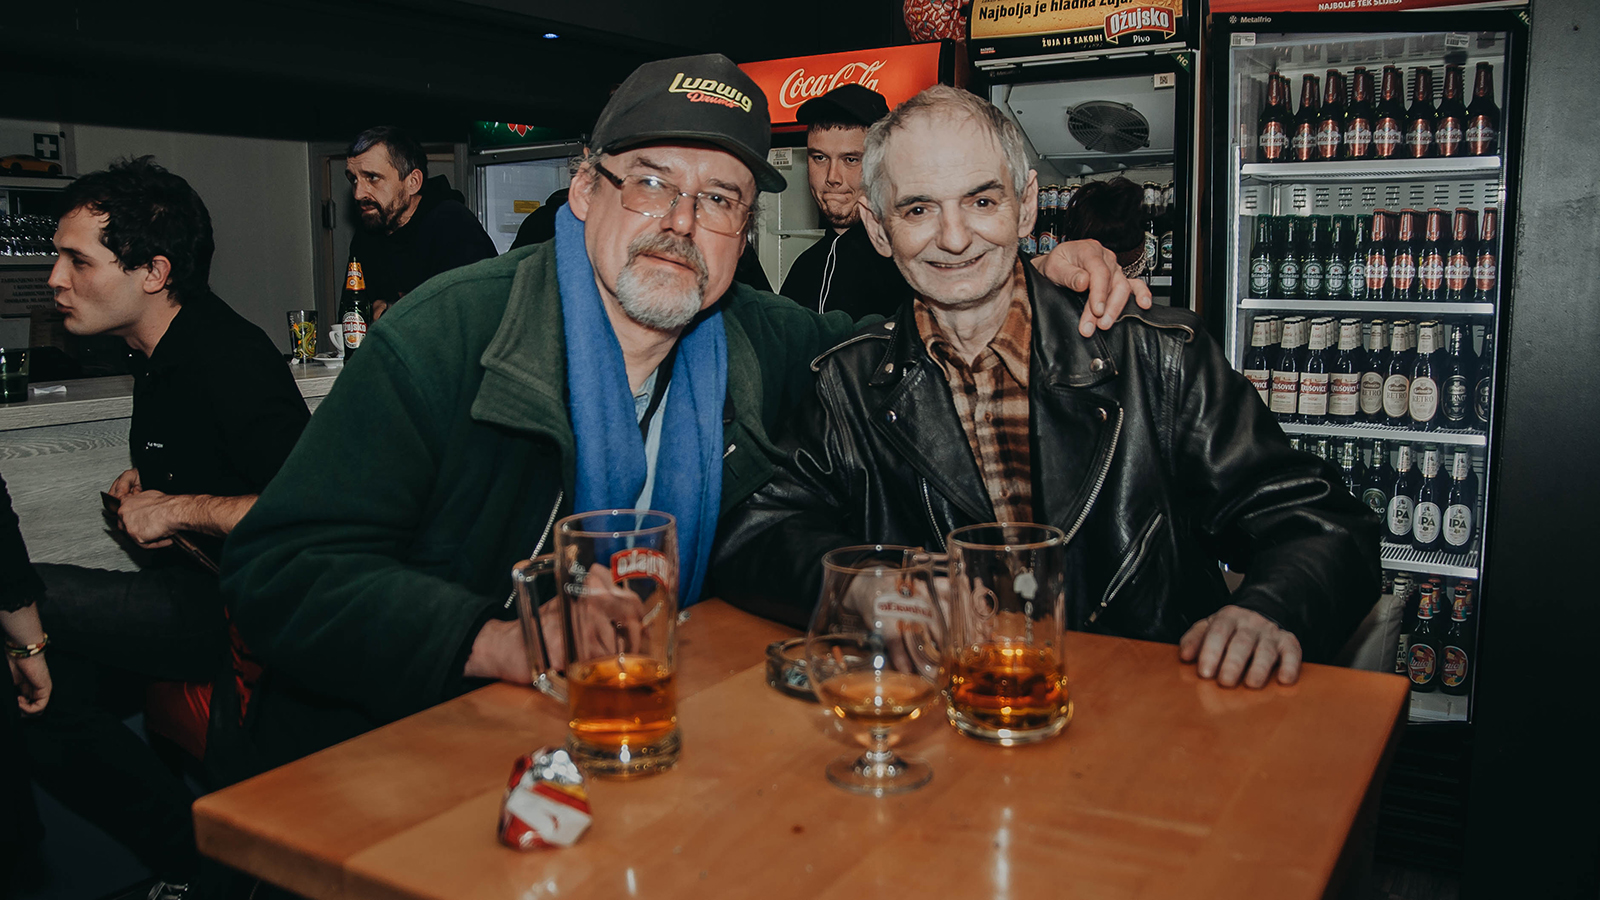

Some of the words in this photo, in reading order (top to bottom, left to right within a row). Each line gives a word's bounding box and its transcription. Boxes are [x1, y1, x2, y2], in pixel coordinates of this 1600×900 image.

[979, 3, 1031, 21] Najbolja
[1033, 1, 1047, 17] je
[1050, 0, 1096, 12] hladna
[1318, 1, 1356, 11] NAJBOLJE
[1110, 8, 1169, 35] Ožujsko
[1240, 16, 1272, 24] Metalfrio
[1042, 37, 1061, 47] ŽUJA
[1063, 37, 1072, 46] JE
[1073, 34, 1104, 45] ZAKON!
[1176, 54, 1189, 67] HC
[779, 59, 888, 109] Coca-Cla
[1386, 391, 1408, 400] RETRO
[1412, 395, 1434, 403] RETRO
[1449, 518, 1467, 529] IPA
